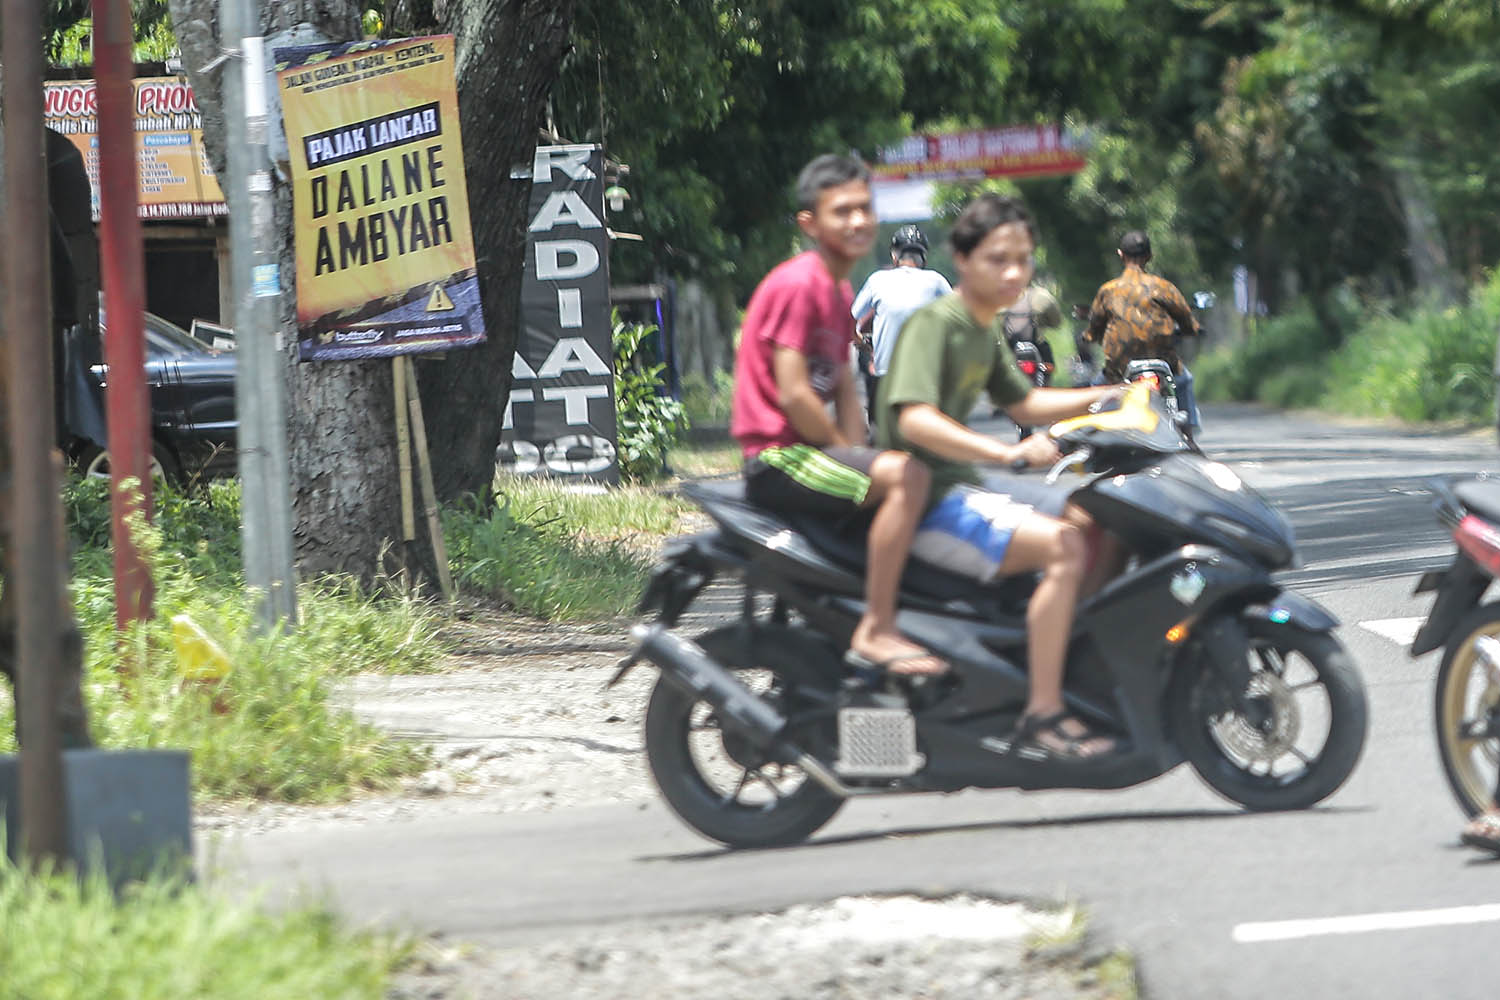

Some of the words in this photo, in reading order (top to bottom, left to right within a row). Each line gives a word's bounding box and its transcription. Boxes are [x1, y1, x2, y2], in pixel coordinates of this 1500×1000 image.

[308, 127, 367, 163] PAJAK
[370, 108, 436, 147] LANCAR
[312, 145, 446, 219] DALANE
[315, 195, 453, 277] AMBYAR
